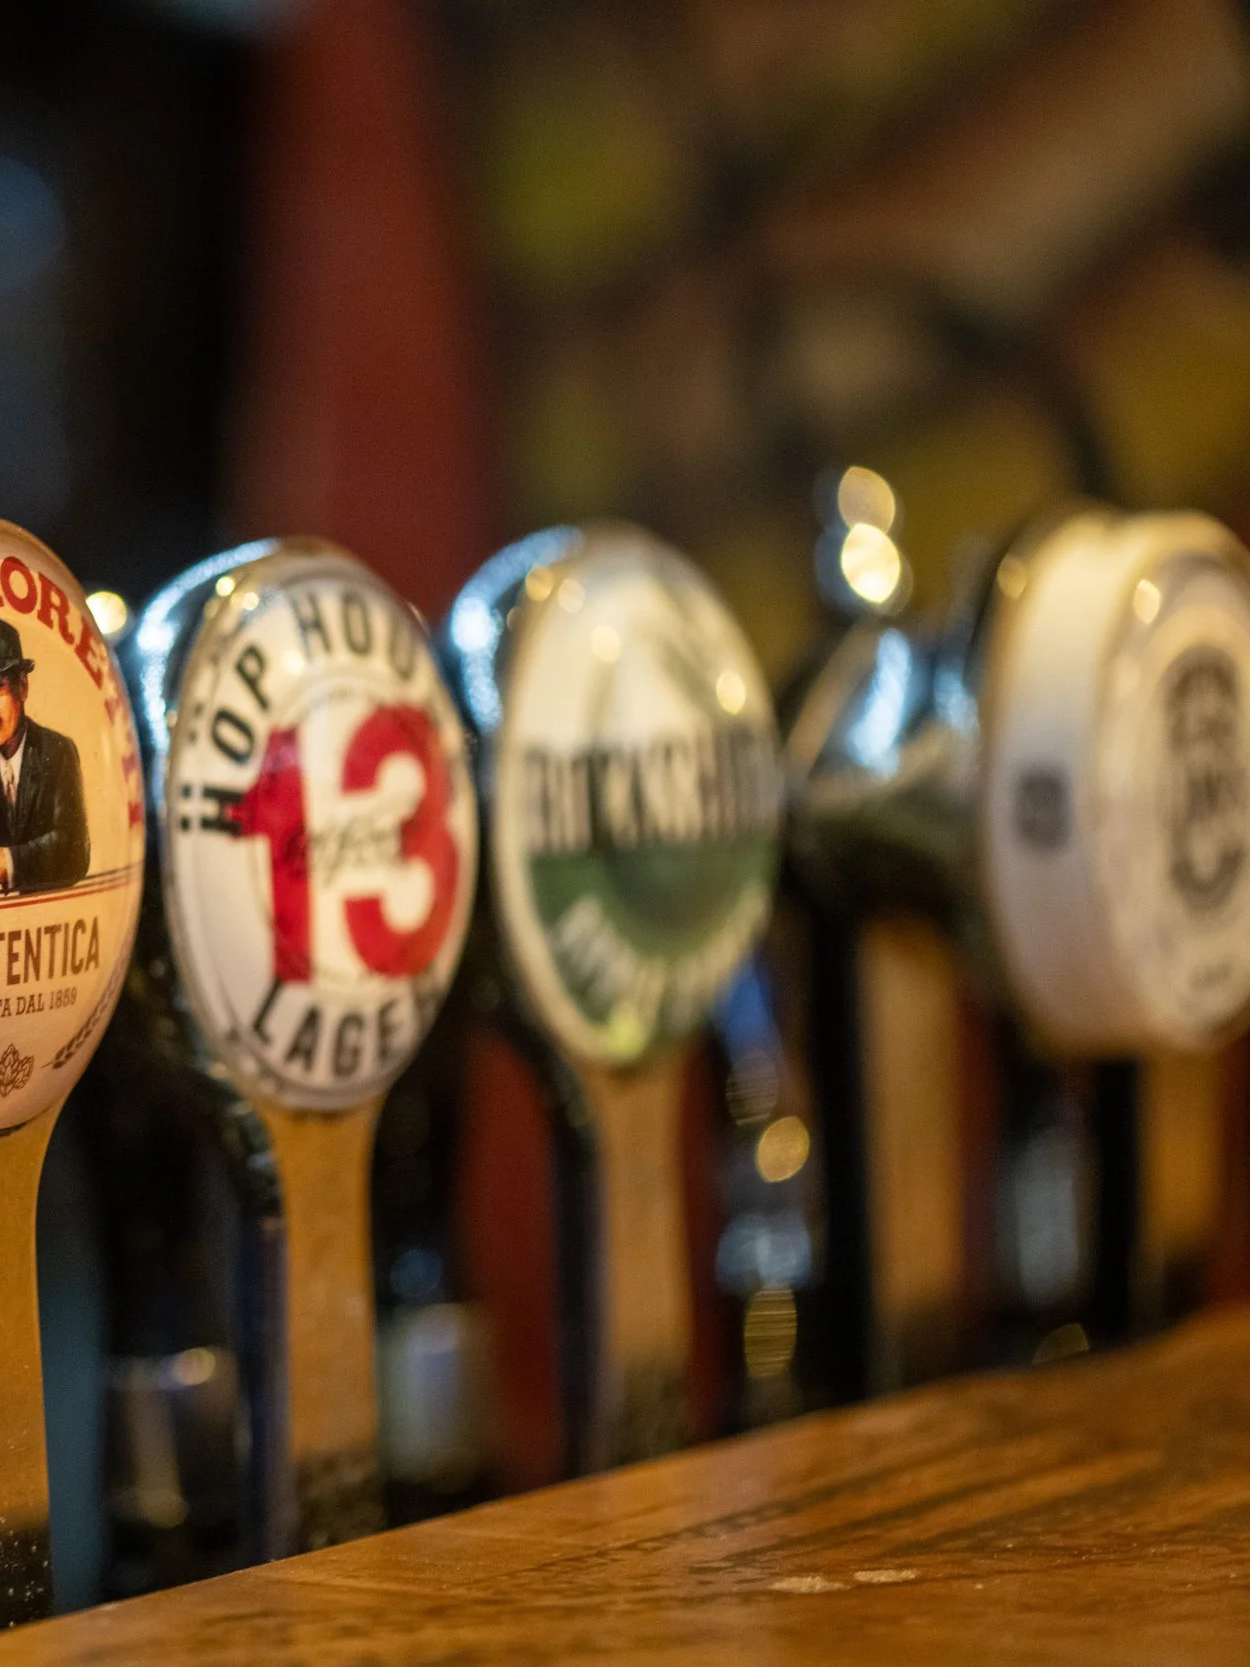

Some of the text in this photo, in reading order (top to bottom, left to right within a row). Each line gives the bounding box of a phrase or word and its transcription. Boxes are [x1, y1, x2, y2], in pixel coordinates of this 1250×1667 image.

[199, 640, 270, 838] HOP
[228, 702, 460, 985] 13
[14, 992, 45, 1017] DAL
[251, 977, 428, 1080] LAGE
